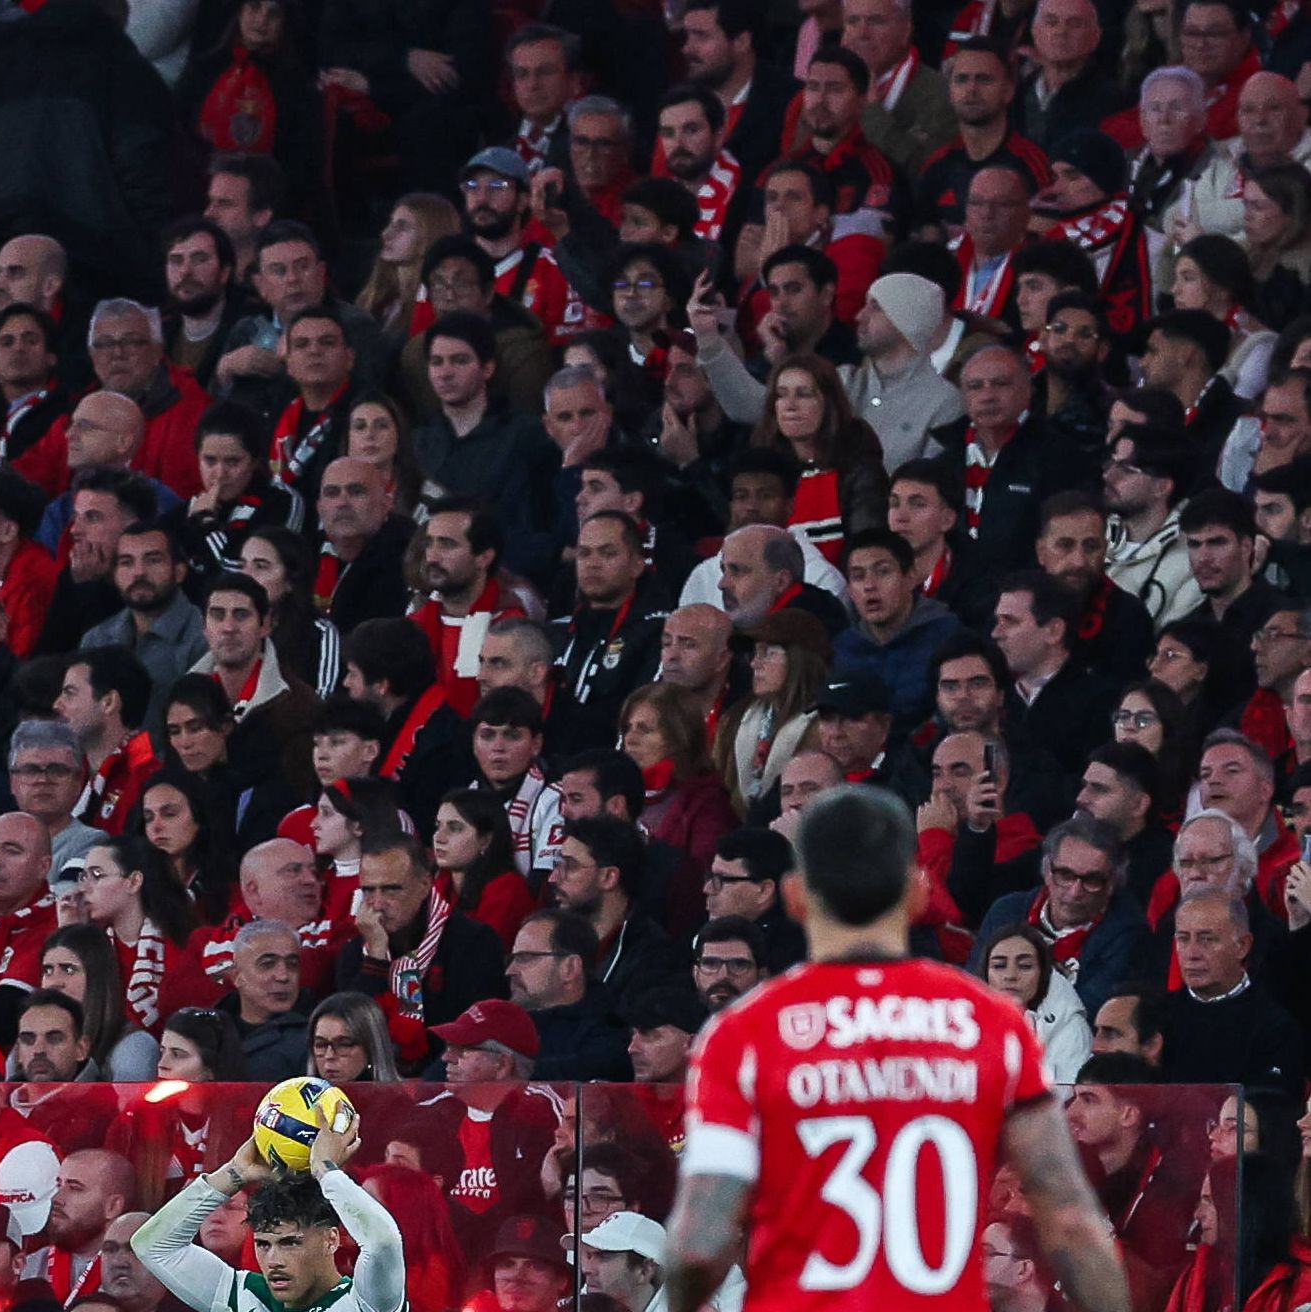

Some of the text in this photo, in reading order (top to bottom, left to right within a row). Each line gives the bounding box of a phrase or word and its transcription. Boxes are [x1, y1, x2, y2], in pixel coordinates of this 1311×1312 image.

[827, 995, 981, 1049] SAGRES
[787, 1056, 978, 1108] OTAMENDI
[795, 1114, 979, 1294] 30
